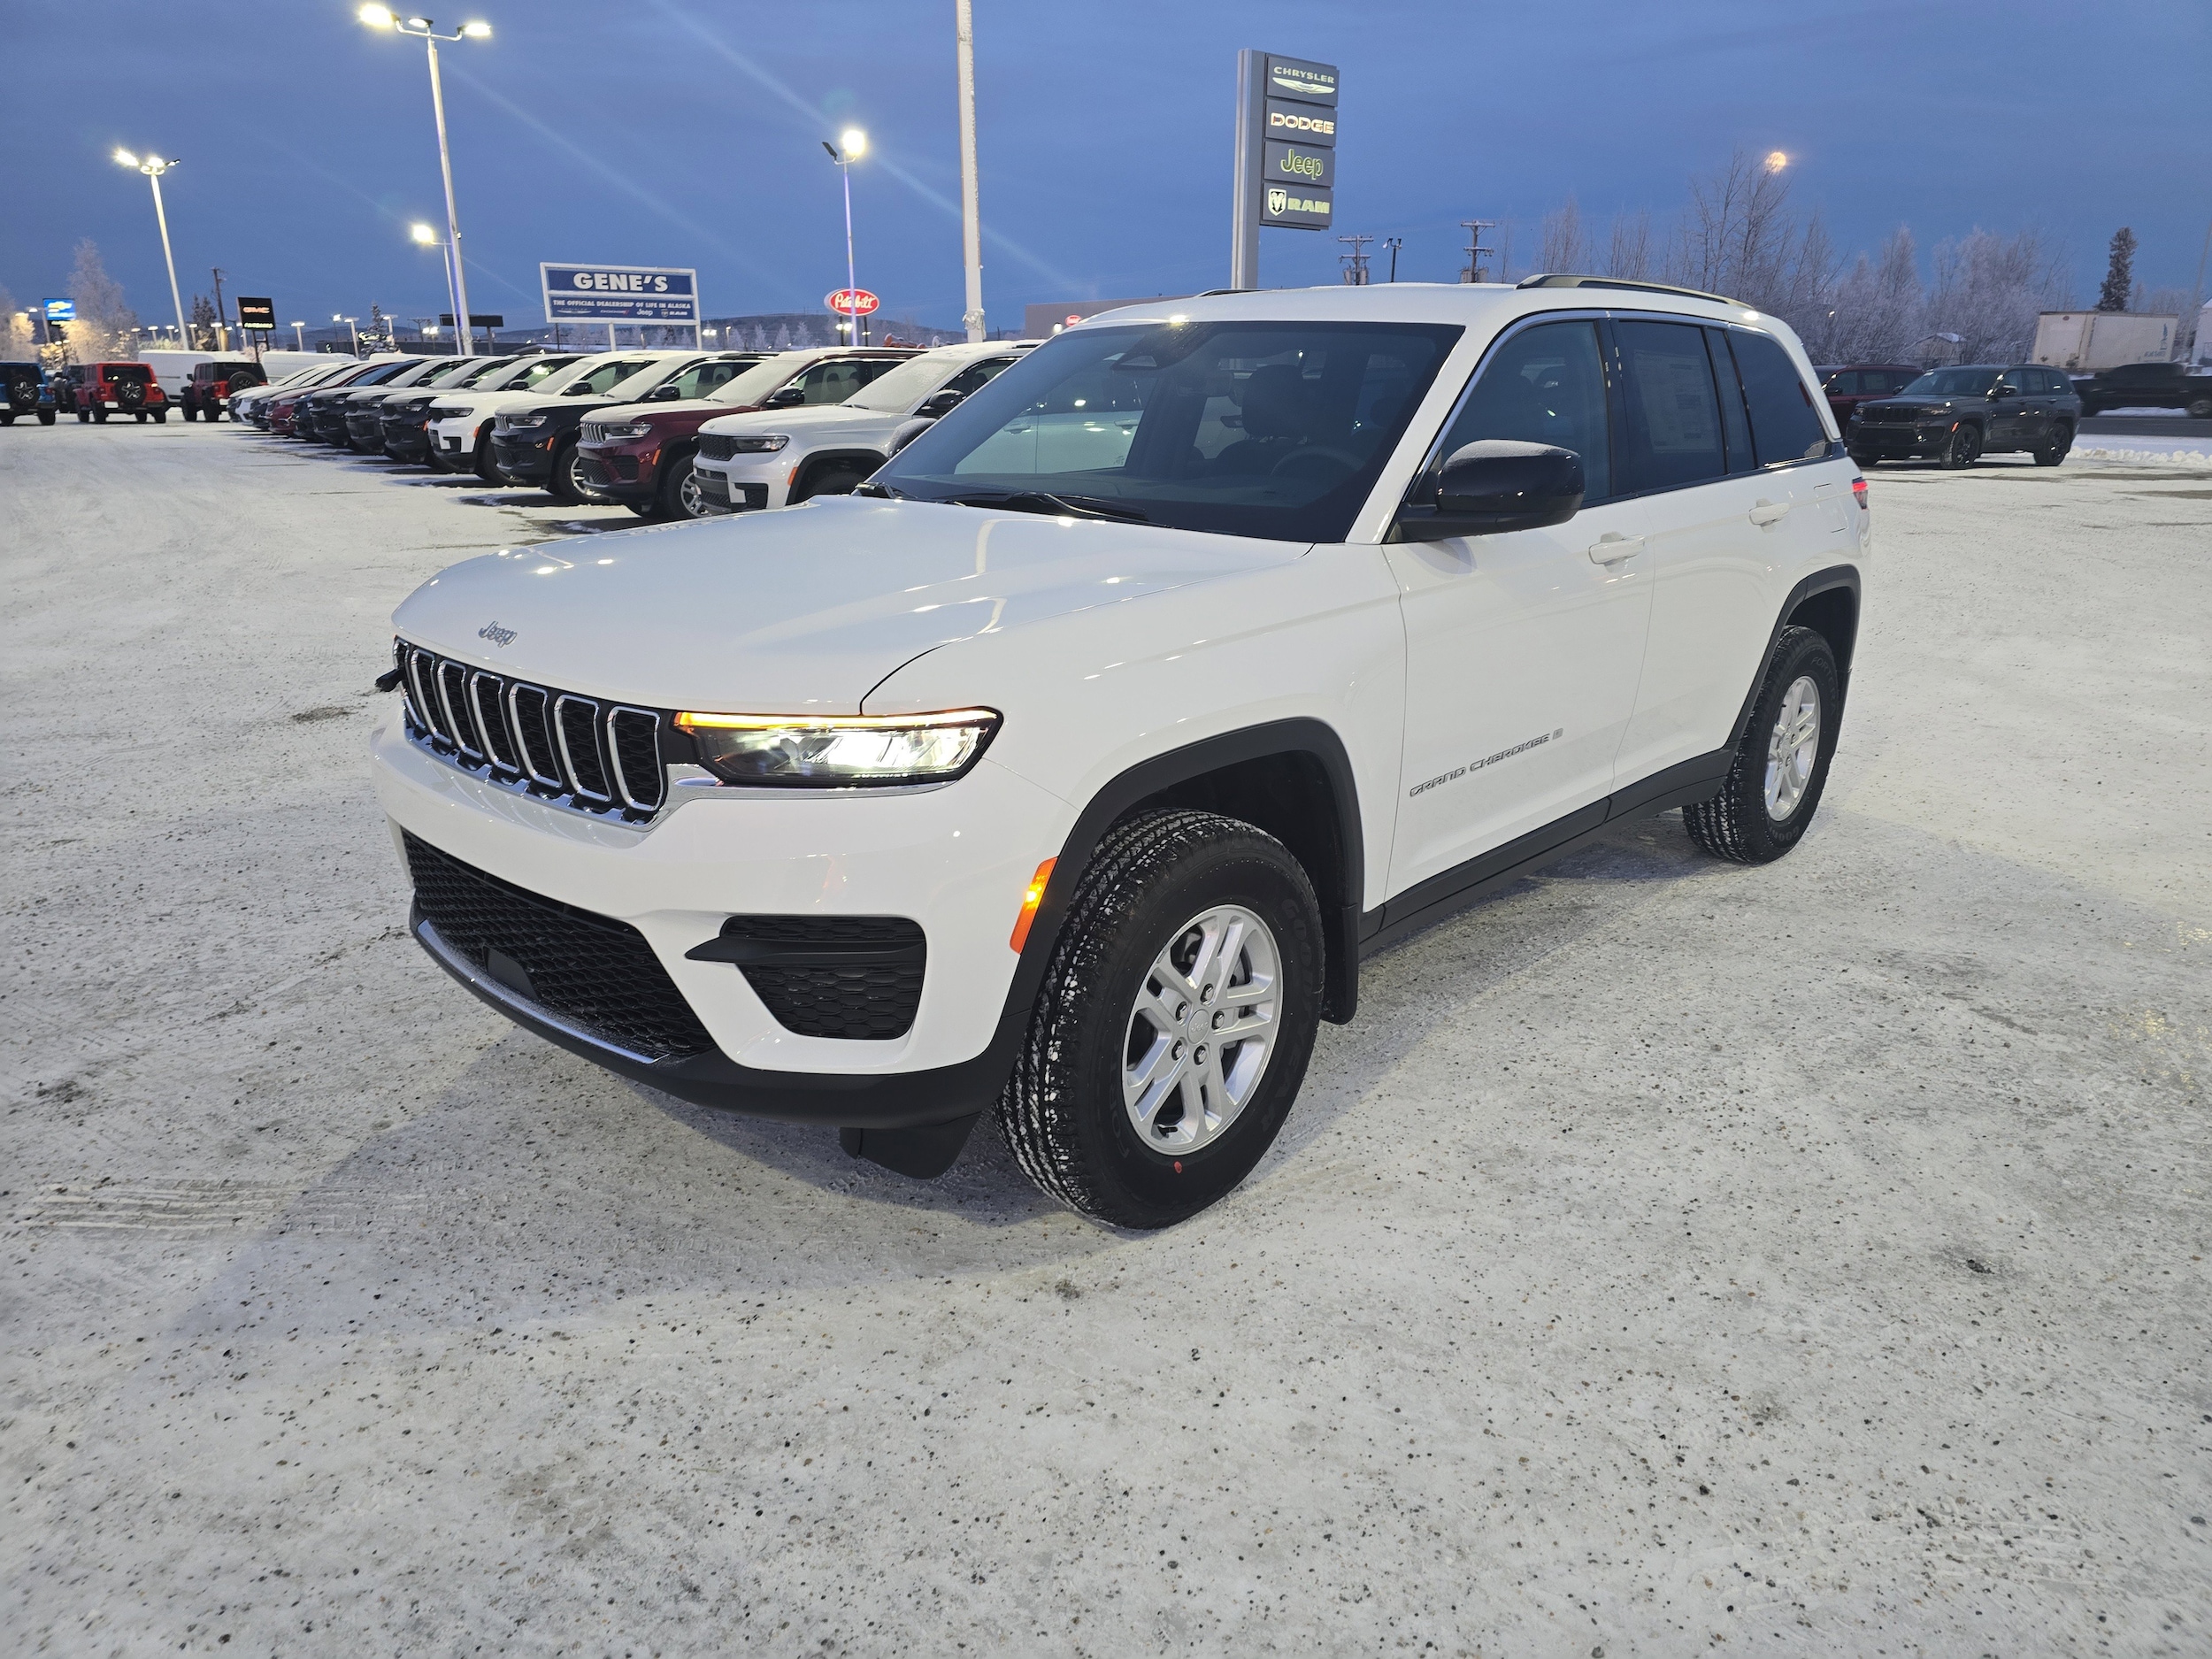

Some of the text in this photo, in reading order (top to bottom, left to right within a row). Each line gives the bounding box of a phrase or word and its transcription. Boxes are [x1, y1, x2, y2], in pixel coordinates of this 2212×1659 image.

[1274, 66, 1334, 83] CHRYSLER
[1271, 112, 1334, 134] DODGE
[1280, 149, 1324, 180] Jeep
[1287, 197, 1330, 213] RAM
[573, 273, 668, 292] GENE'S
[834, 293, 876, 309] Petebilt
[479, 620, 518, 648] Jeep
[1409, 733, 1550, 797] GRAND CHEROKEE
